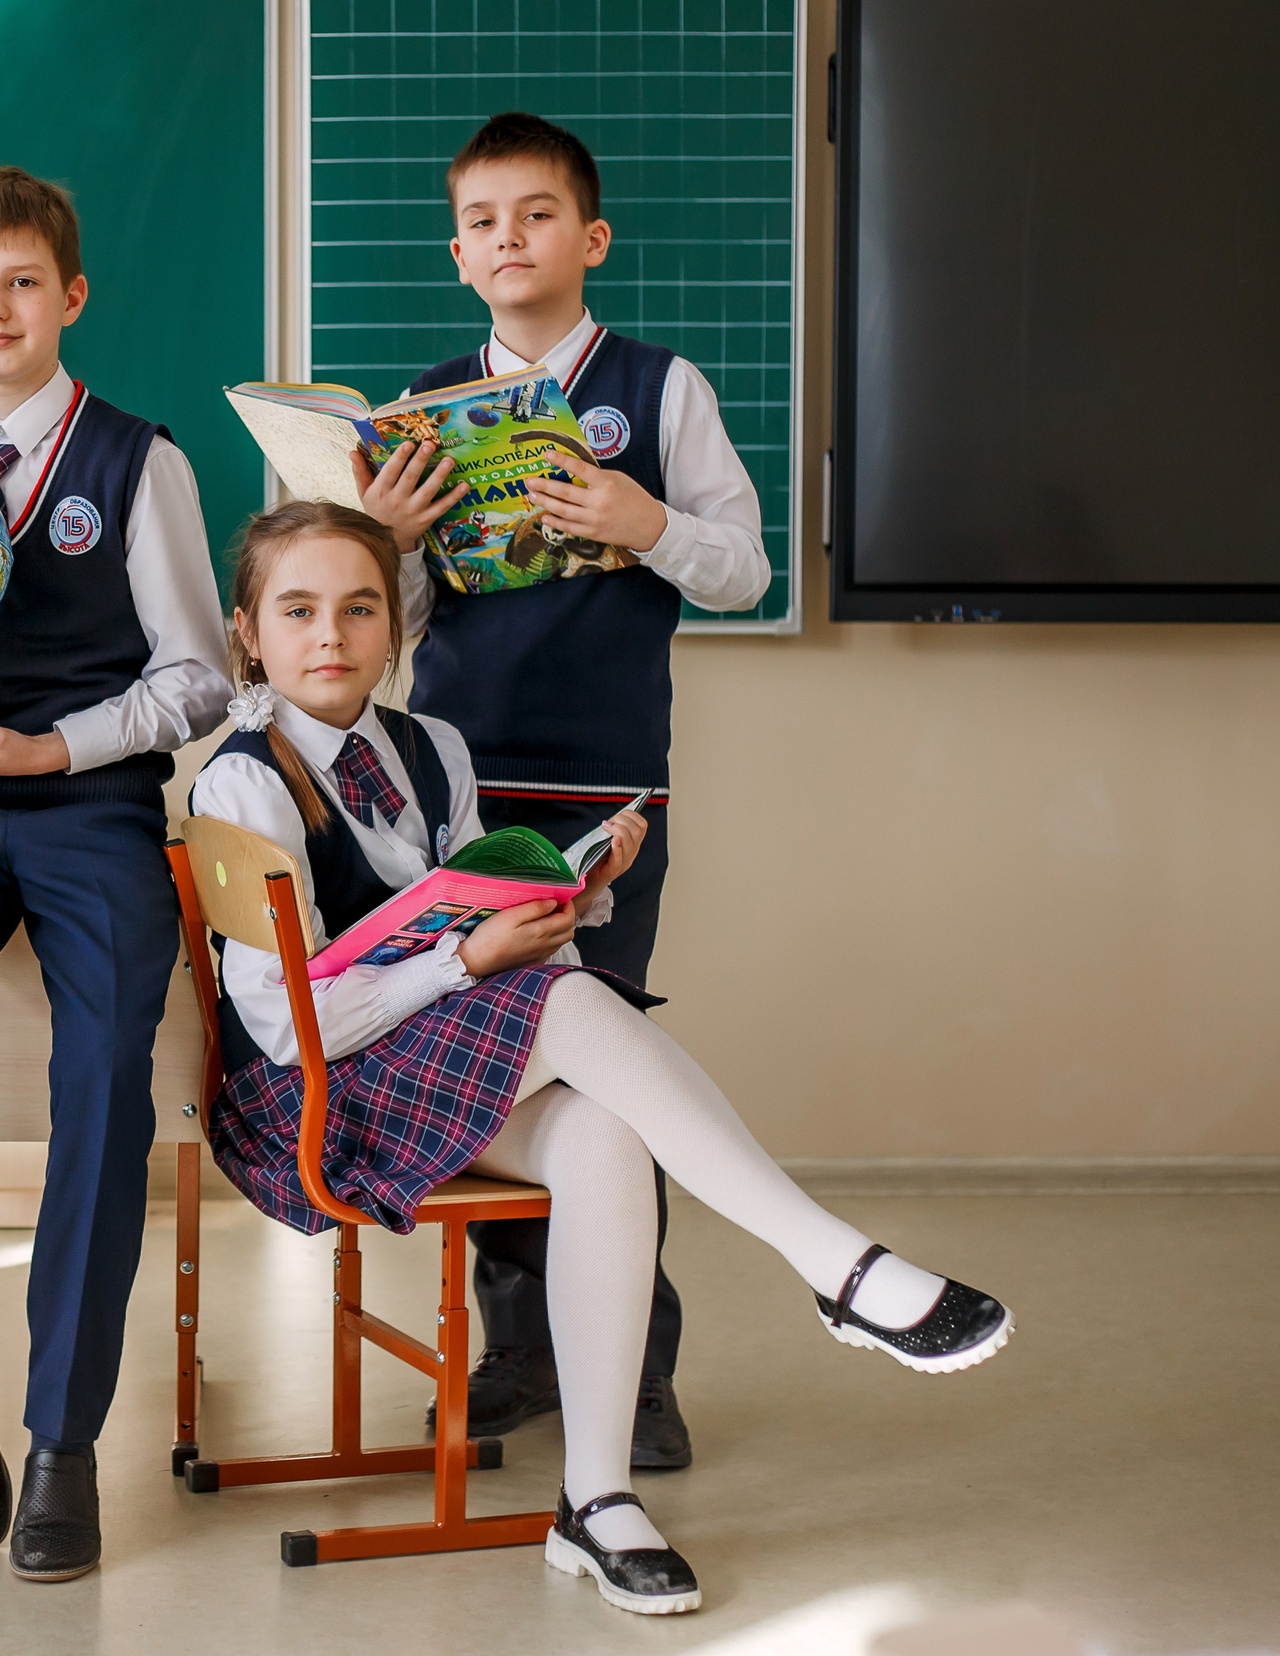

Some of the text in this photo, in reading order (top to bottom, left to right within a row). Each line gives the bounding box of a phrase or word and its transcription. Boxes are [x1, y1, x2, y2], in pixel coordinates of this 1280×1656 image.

[589, 421, 615, 443] 15
[450, 443, 556, 474] ЦИКЛОПЕДИЯ
[70, 499, 100, 530] ОБРАЗОВАНИЯ
[62, 515, 86, 537] 15
[58, 542, 91, 553] ВЫСОТА
